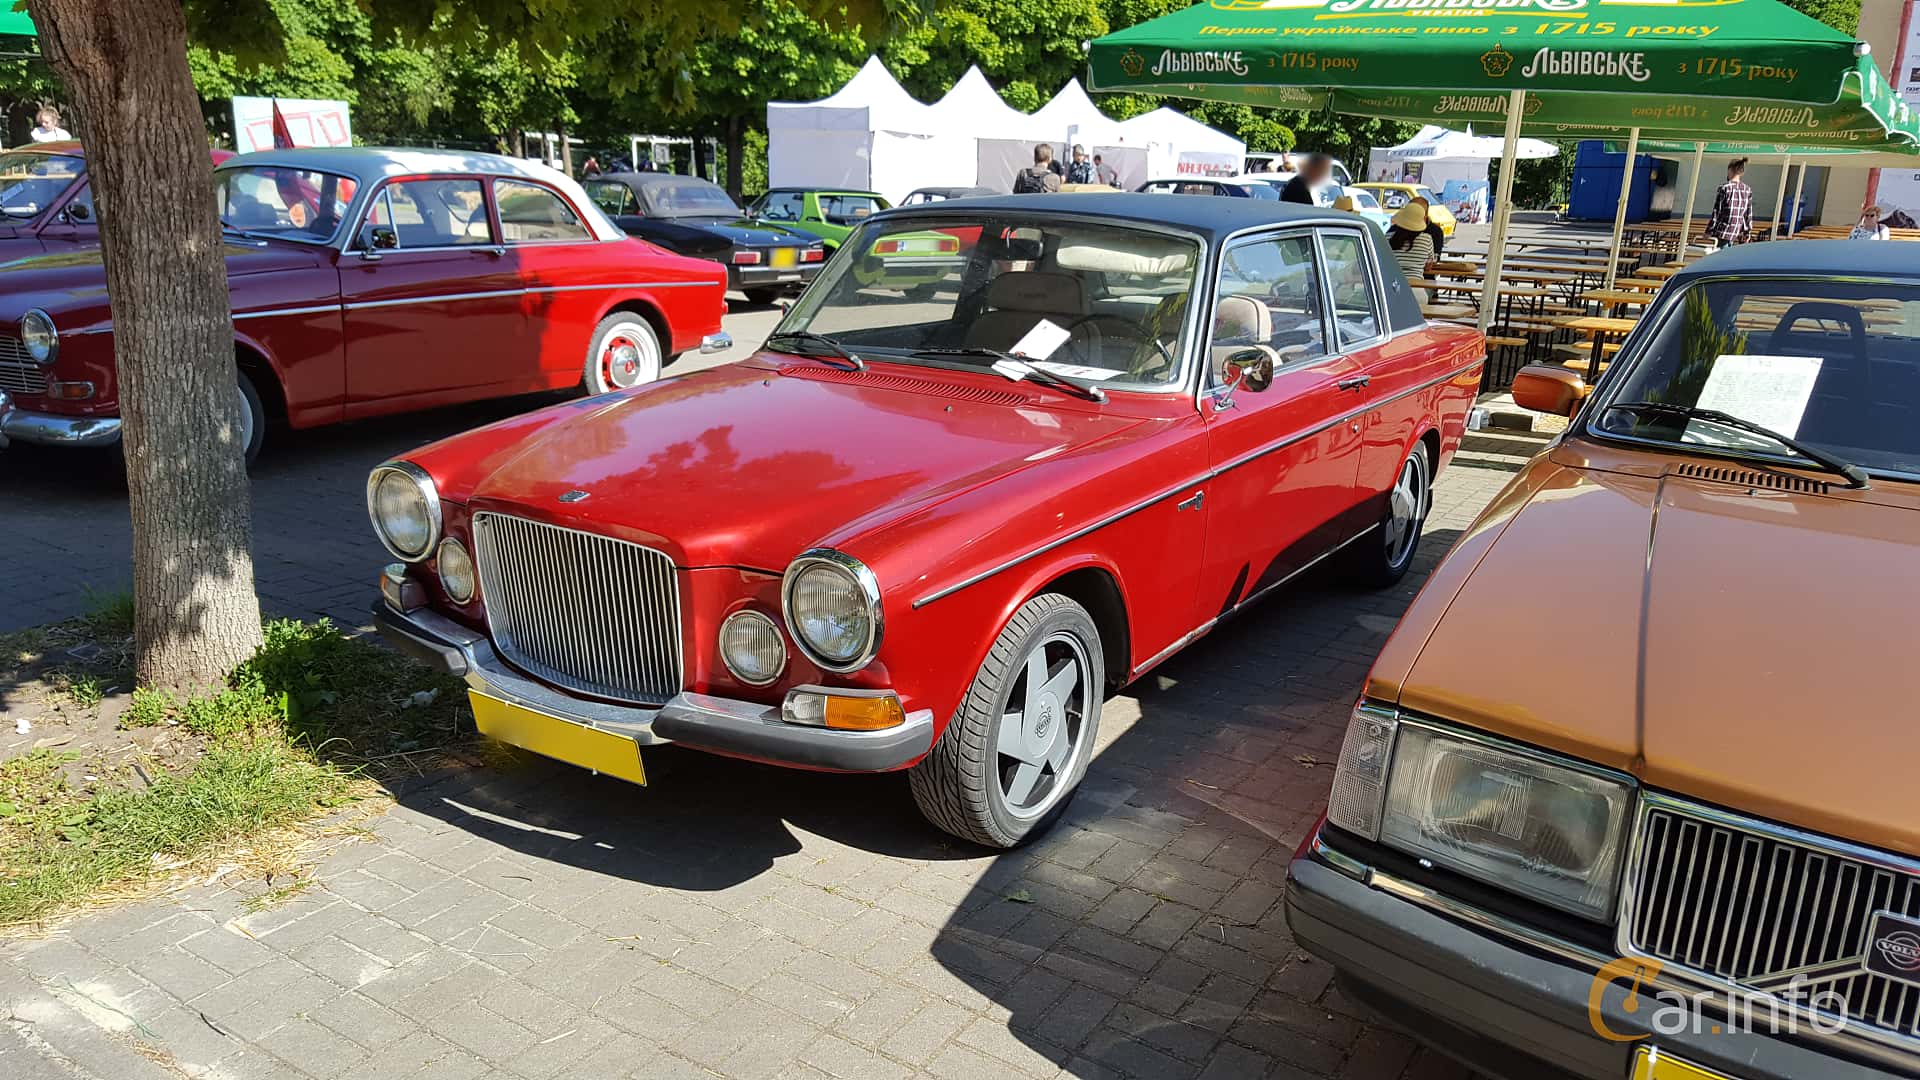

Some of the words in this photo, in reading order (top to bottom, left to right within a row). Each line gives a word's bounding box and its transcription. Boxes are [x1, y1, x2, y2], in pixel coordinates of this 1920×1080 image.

[1199, 25, 1277, 36] Перше
[1280, 25, 1418, 36] українське
[1424, 26, 1489, 34] пиво
[1535, 22, 1617, 35] 1715
[1625, 25, 1720, 37] року
[1152, 49, 1249, 76] ЛЬВІВСЬКЕ
[1281, 52, 1317, 68] 1715
[1321, 55, 1360, 72] року
[1521, 47, 1651, 81] ЛЬВІВСЬКЕ
[1695, 57, 1742, 76] 1715
[1747, 64, 1800, 83] року
